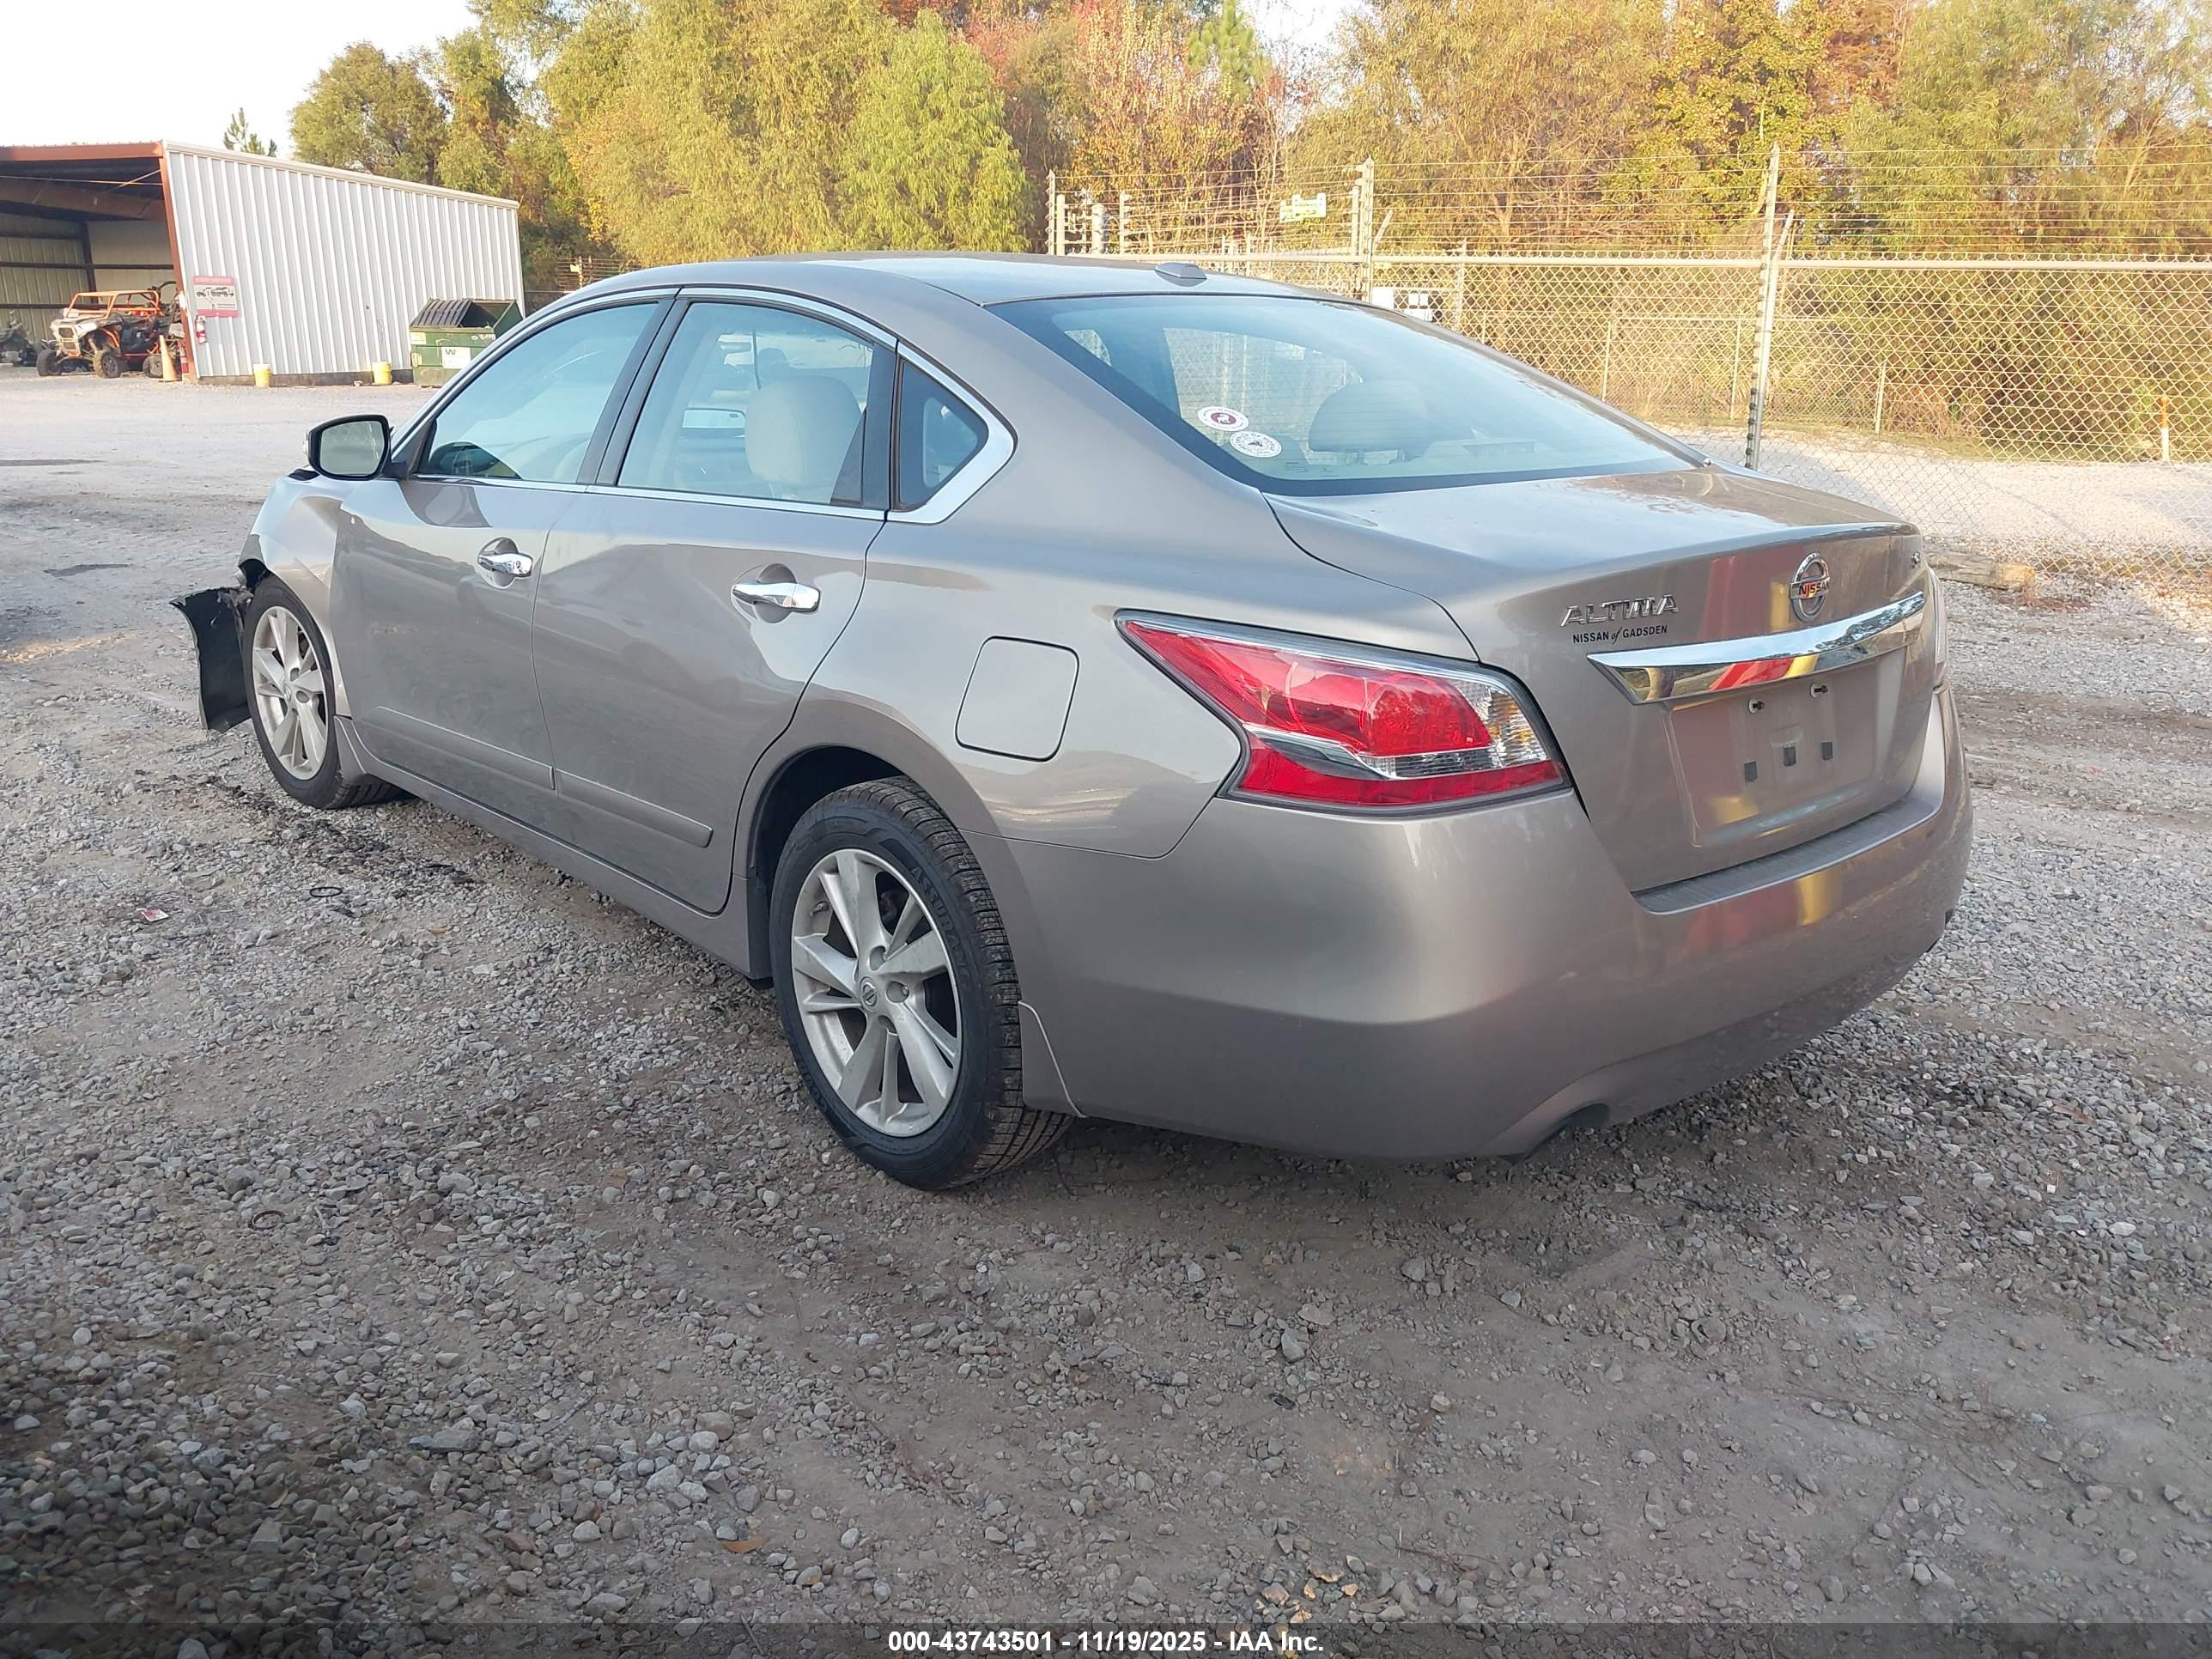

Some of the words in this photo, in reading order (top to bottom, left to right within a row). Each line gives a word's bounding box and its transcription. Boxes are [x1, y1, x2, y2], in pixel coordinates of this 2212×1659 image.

[1799, 581, 1830, 597] NISSAN
[1560, 594, 1679, 627] ALTIMA
[1572, 631, 1609, 644] NISSAN
[1611, 627, 1623, 645] of
[1622, 625, 1668, 639] GADSDEN
